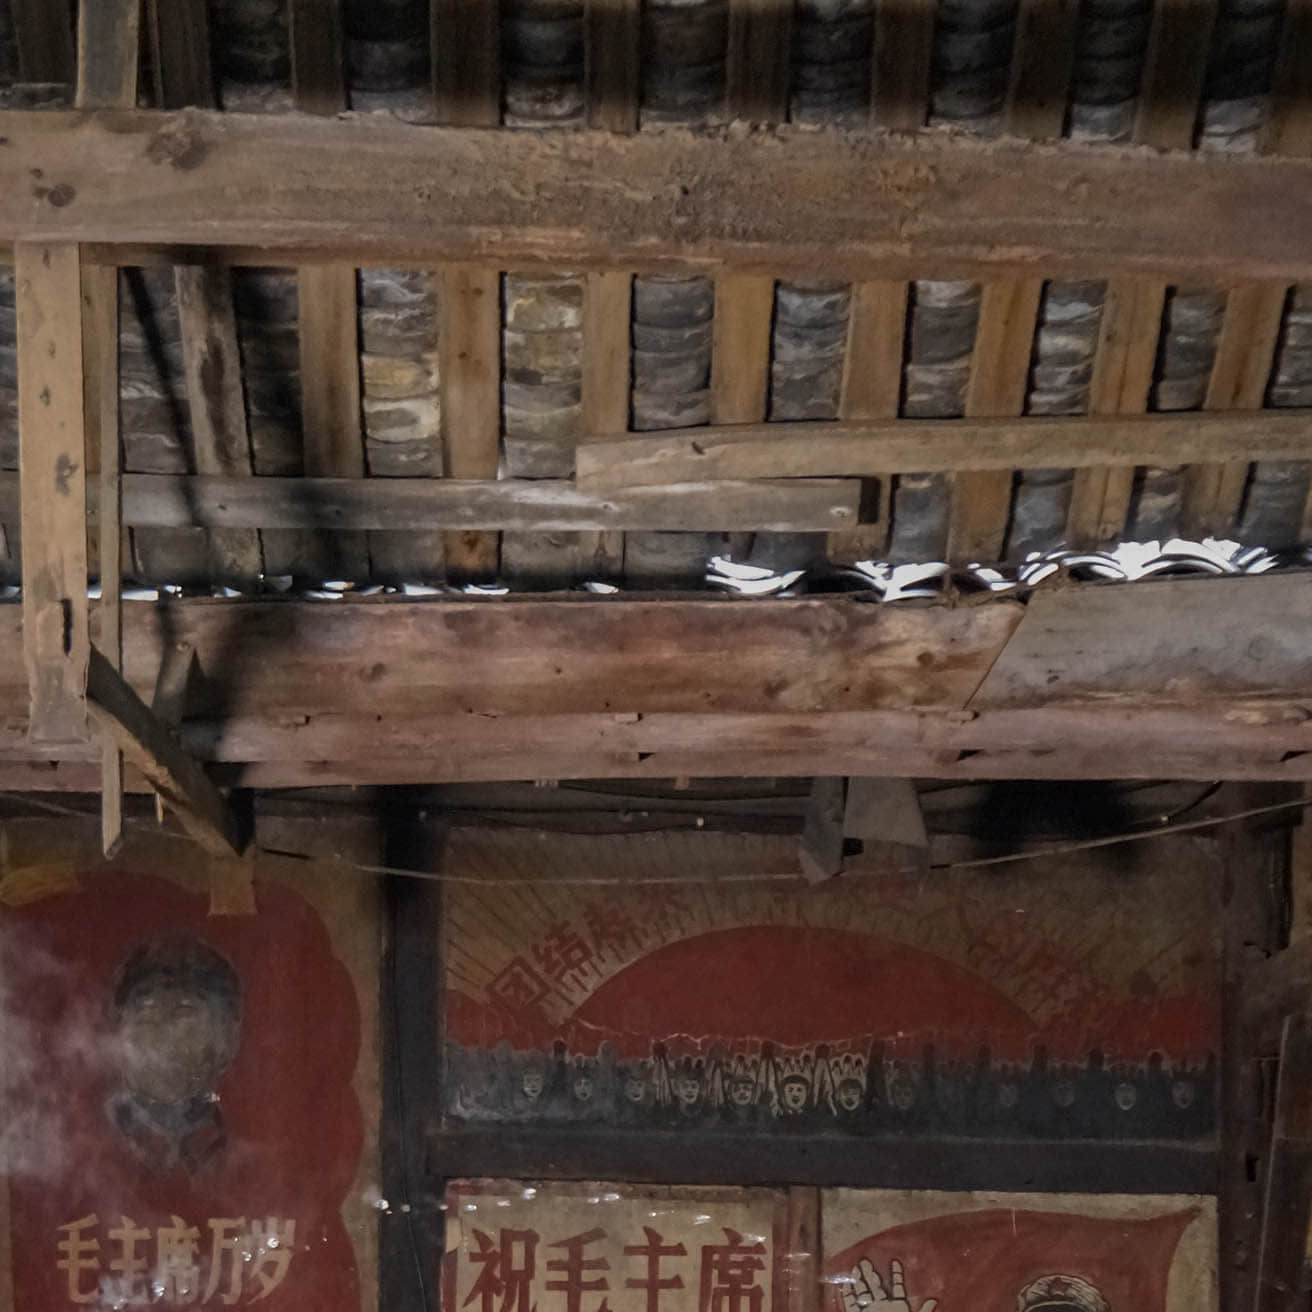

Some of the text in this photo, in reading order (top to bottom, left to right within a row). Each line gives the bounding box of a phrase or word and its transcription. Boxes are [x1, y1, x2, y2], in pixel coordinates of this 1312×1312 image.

[55, 1212, 296, 1305] 毛主席万岁
